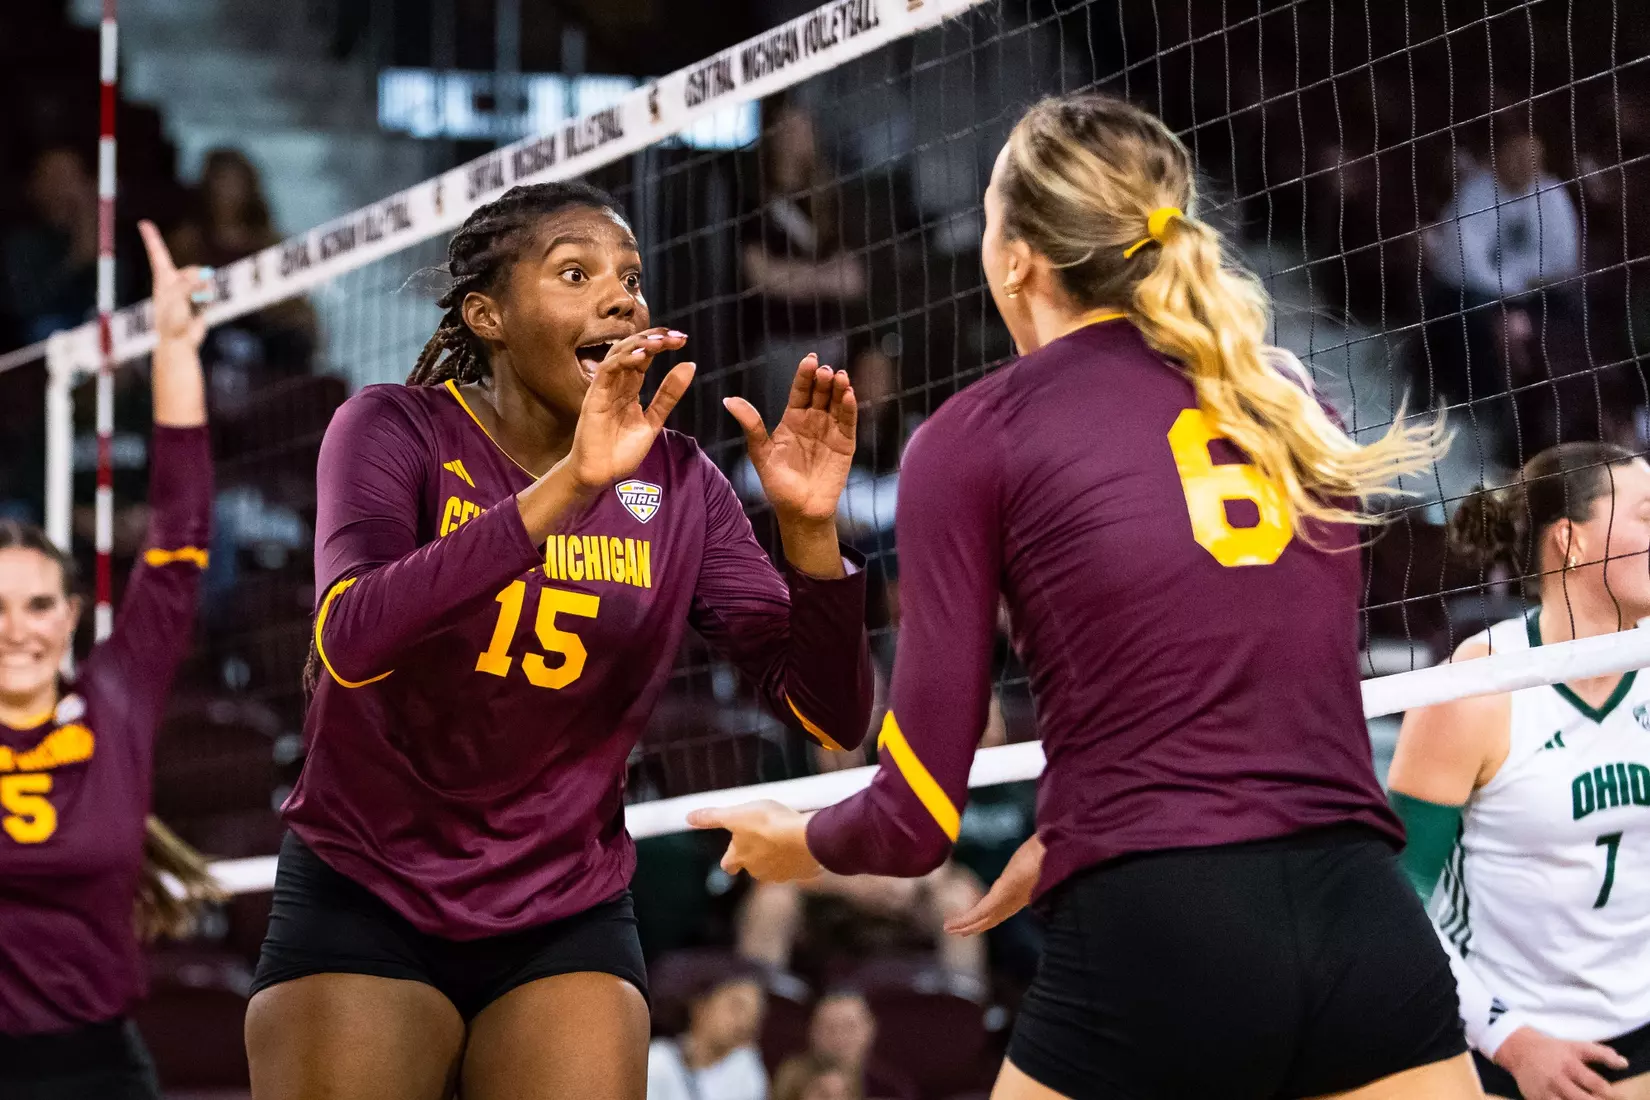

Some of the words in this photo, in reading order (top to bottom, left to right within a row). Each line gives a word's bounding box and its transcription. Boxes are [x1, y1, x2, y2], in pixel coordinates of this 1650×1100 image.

[620, 493, 660, 506] MAC
[1167, 408, 1294, 568] 6
[543, 534, 652, 589] MICHIGAN
[475, 579, 600, 691] 15
[1572, 762, 1650, 821] OHIO
[1593, 830, 1623, 910] 7
